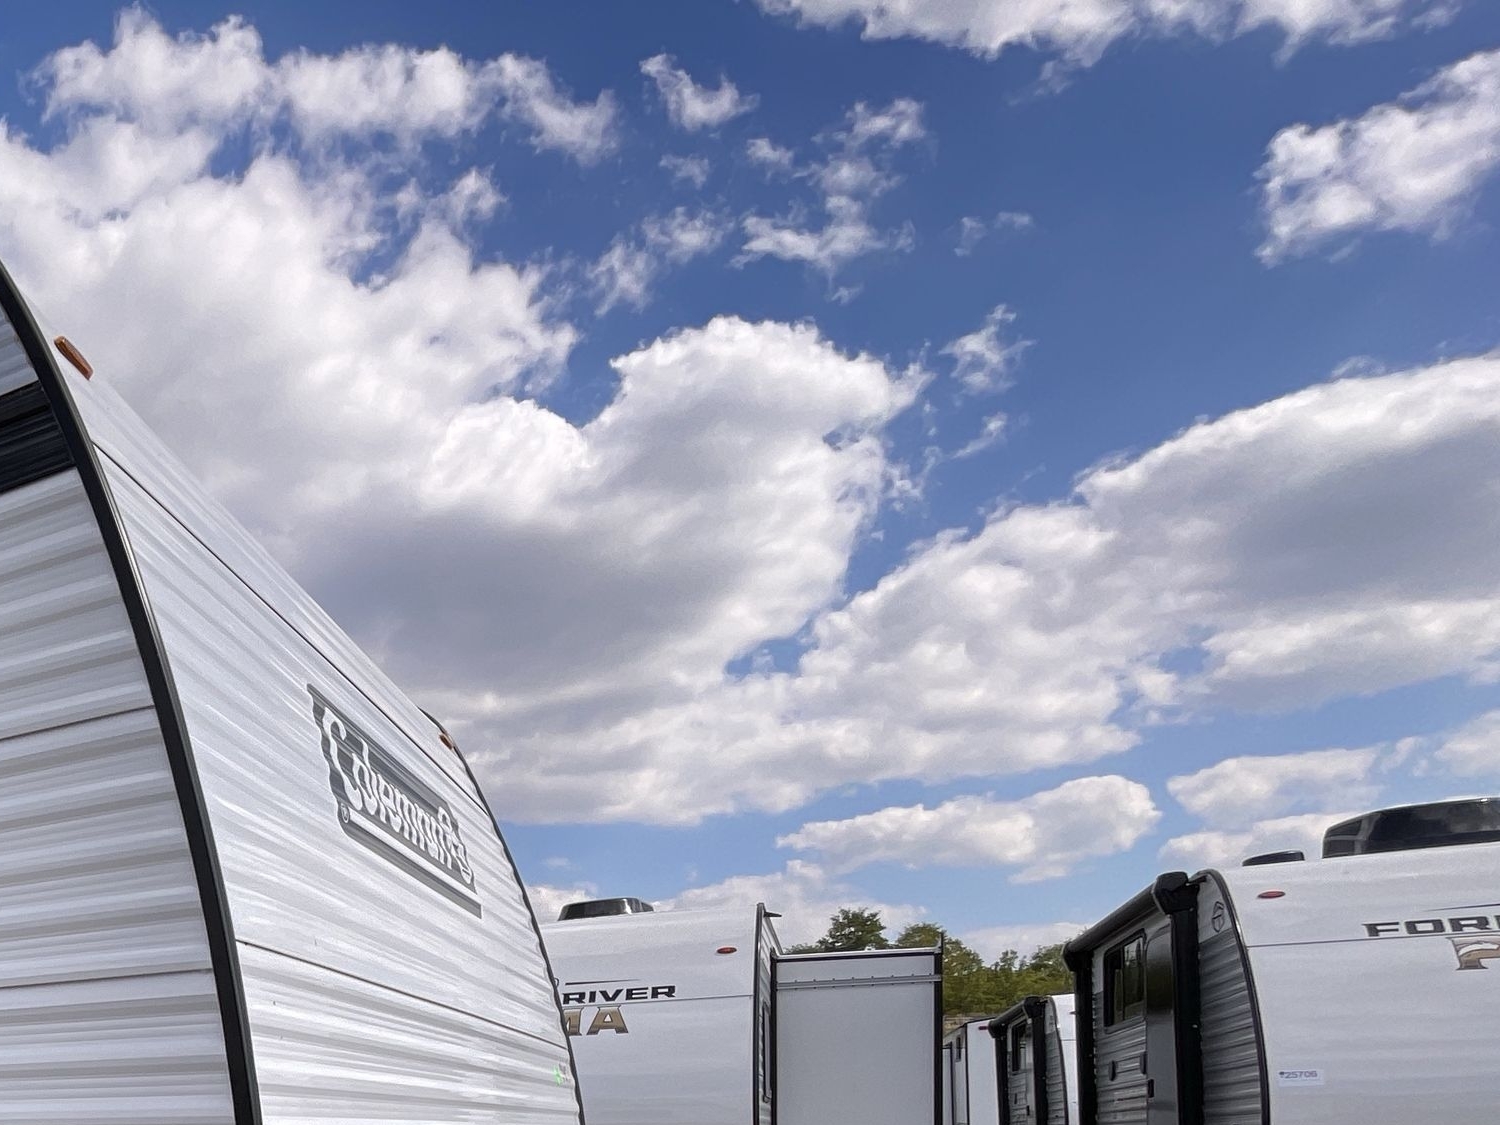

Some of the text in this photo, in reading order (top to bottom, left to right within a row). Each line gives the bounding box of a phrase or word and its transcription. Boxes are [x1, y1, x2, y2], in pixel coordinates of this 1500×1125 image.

[322, 706, 453, 870] Coleman
[1361, 915, 1500, 937] FOR
[562, 985, 676, 1005] RIVER
